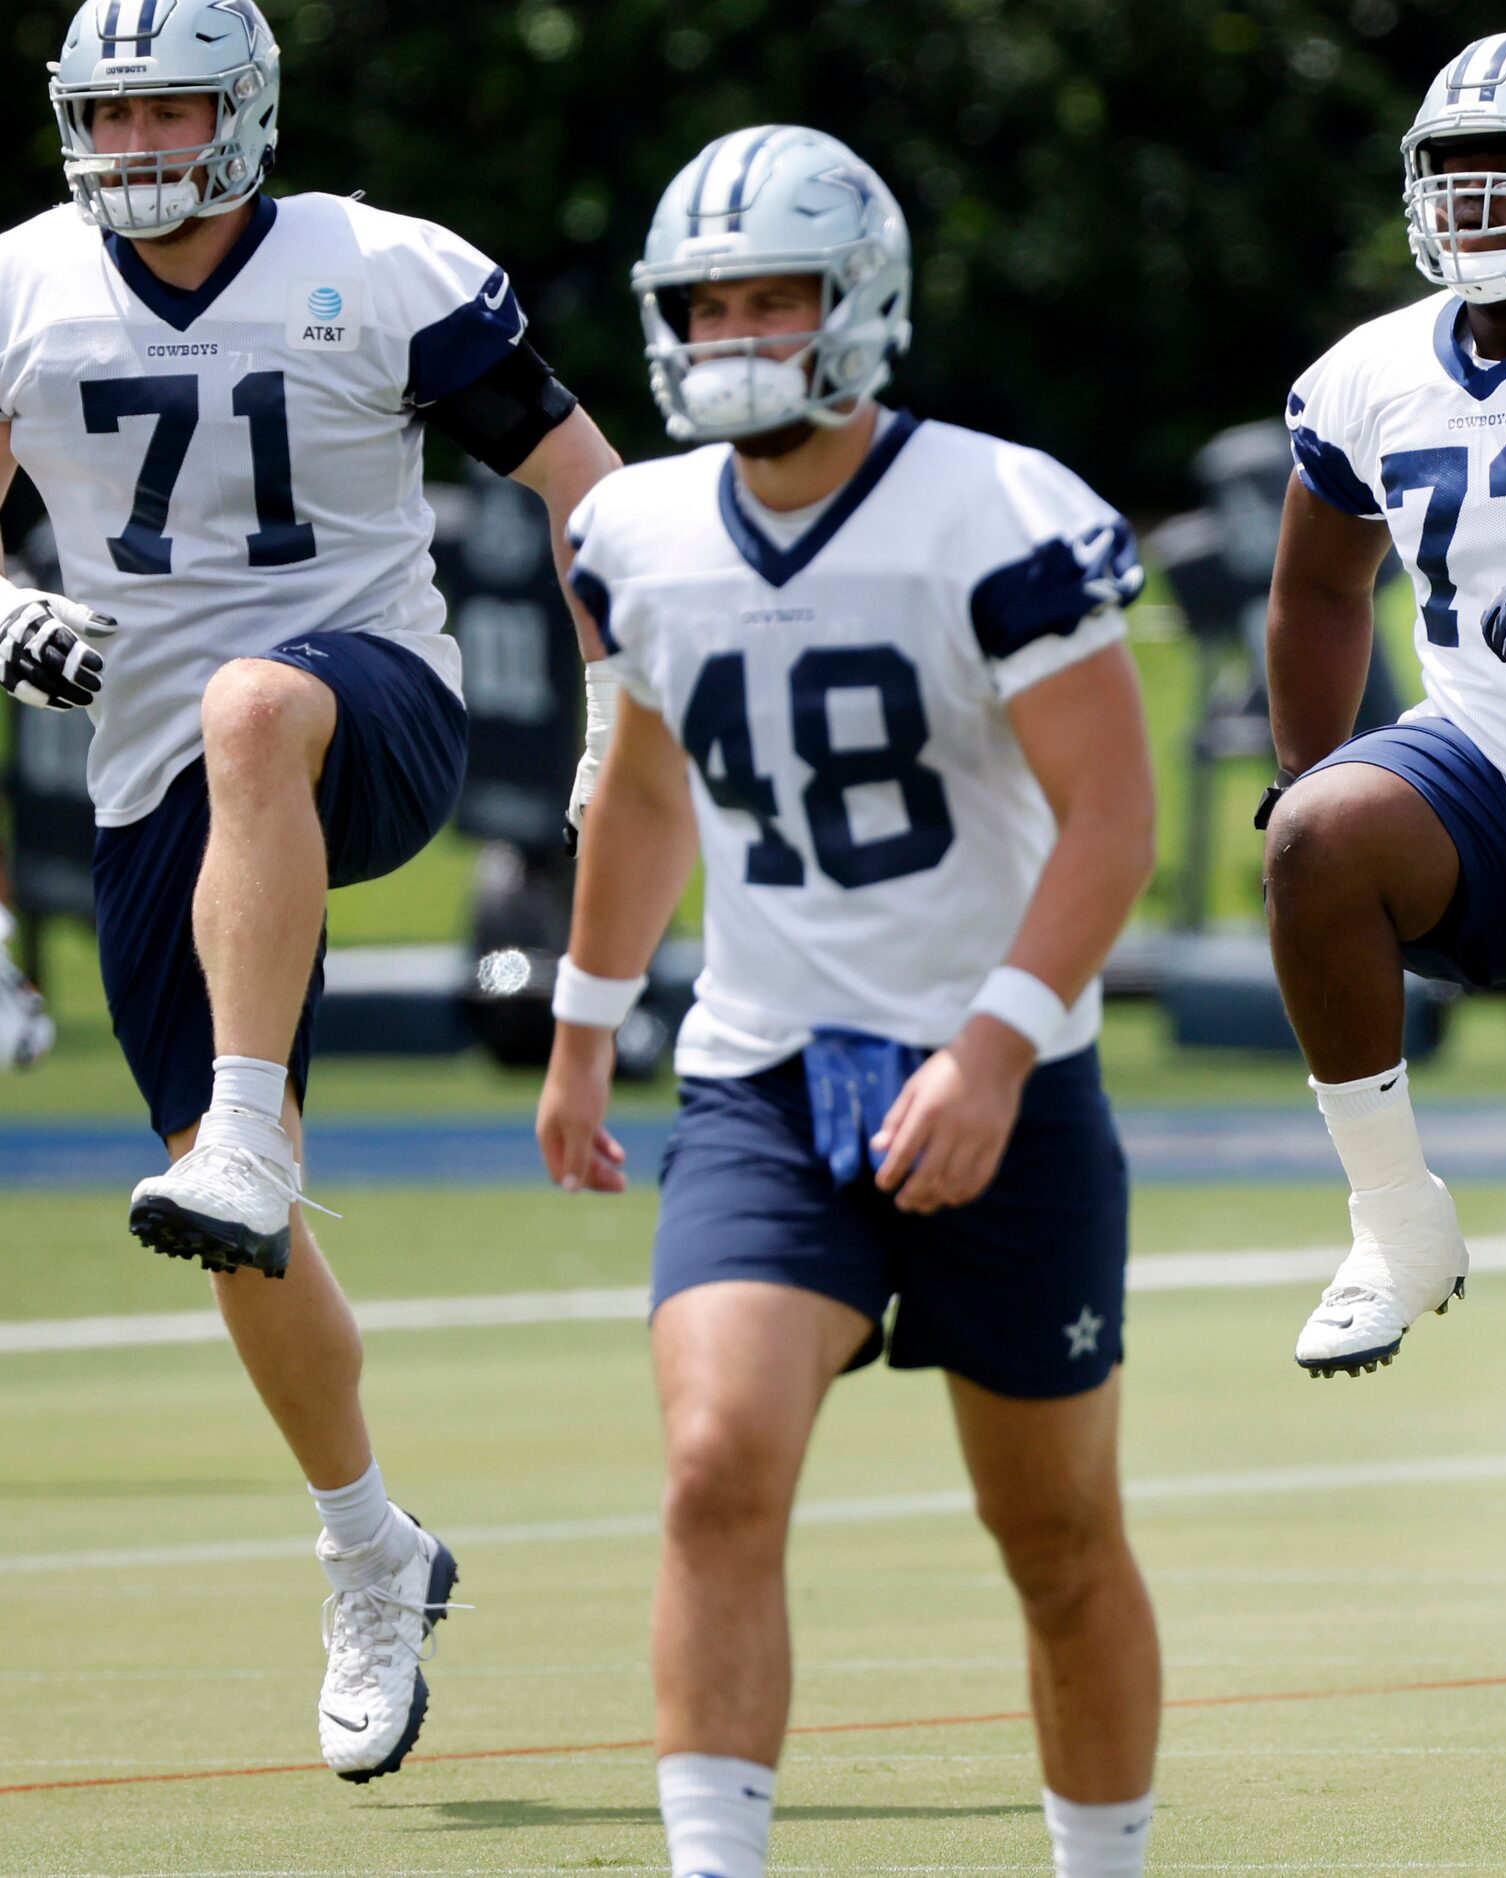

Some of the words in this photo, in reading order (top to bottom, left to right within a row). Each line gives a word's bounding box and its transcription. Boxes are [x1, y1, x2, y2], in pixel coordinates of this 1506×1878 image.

[105, 65, 147, 75] COWBOYS
[302, 326, 345, 342] AT&T
[147, 343, 218, 357] COWBOYS
[80, 370, 317, 574] 71
[681, 640, 956, 890] 48
